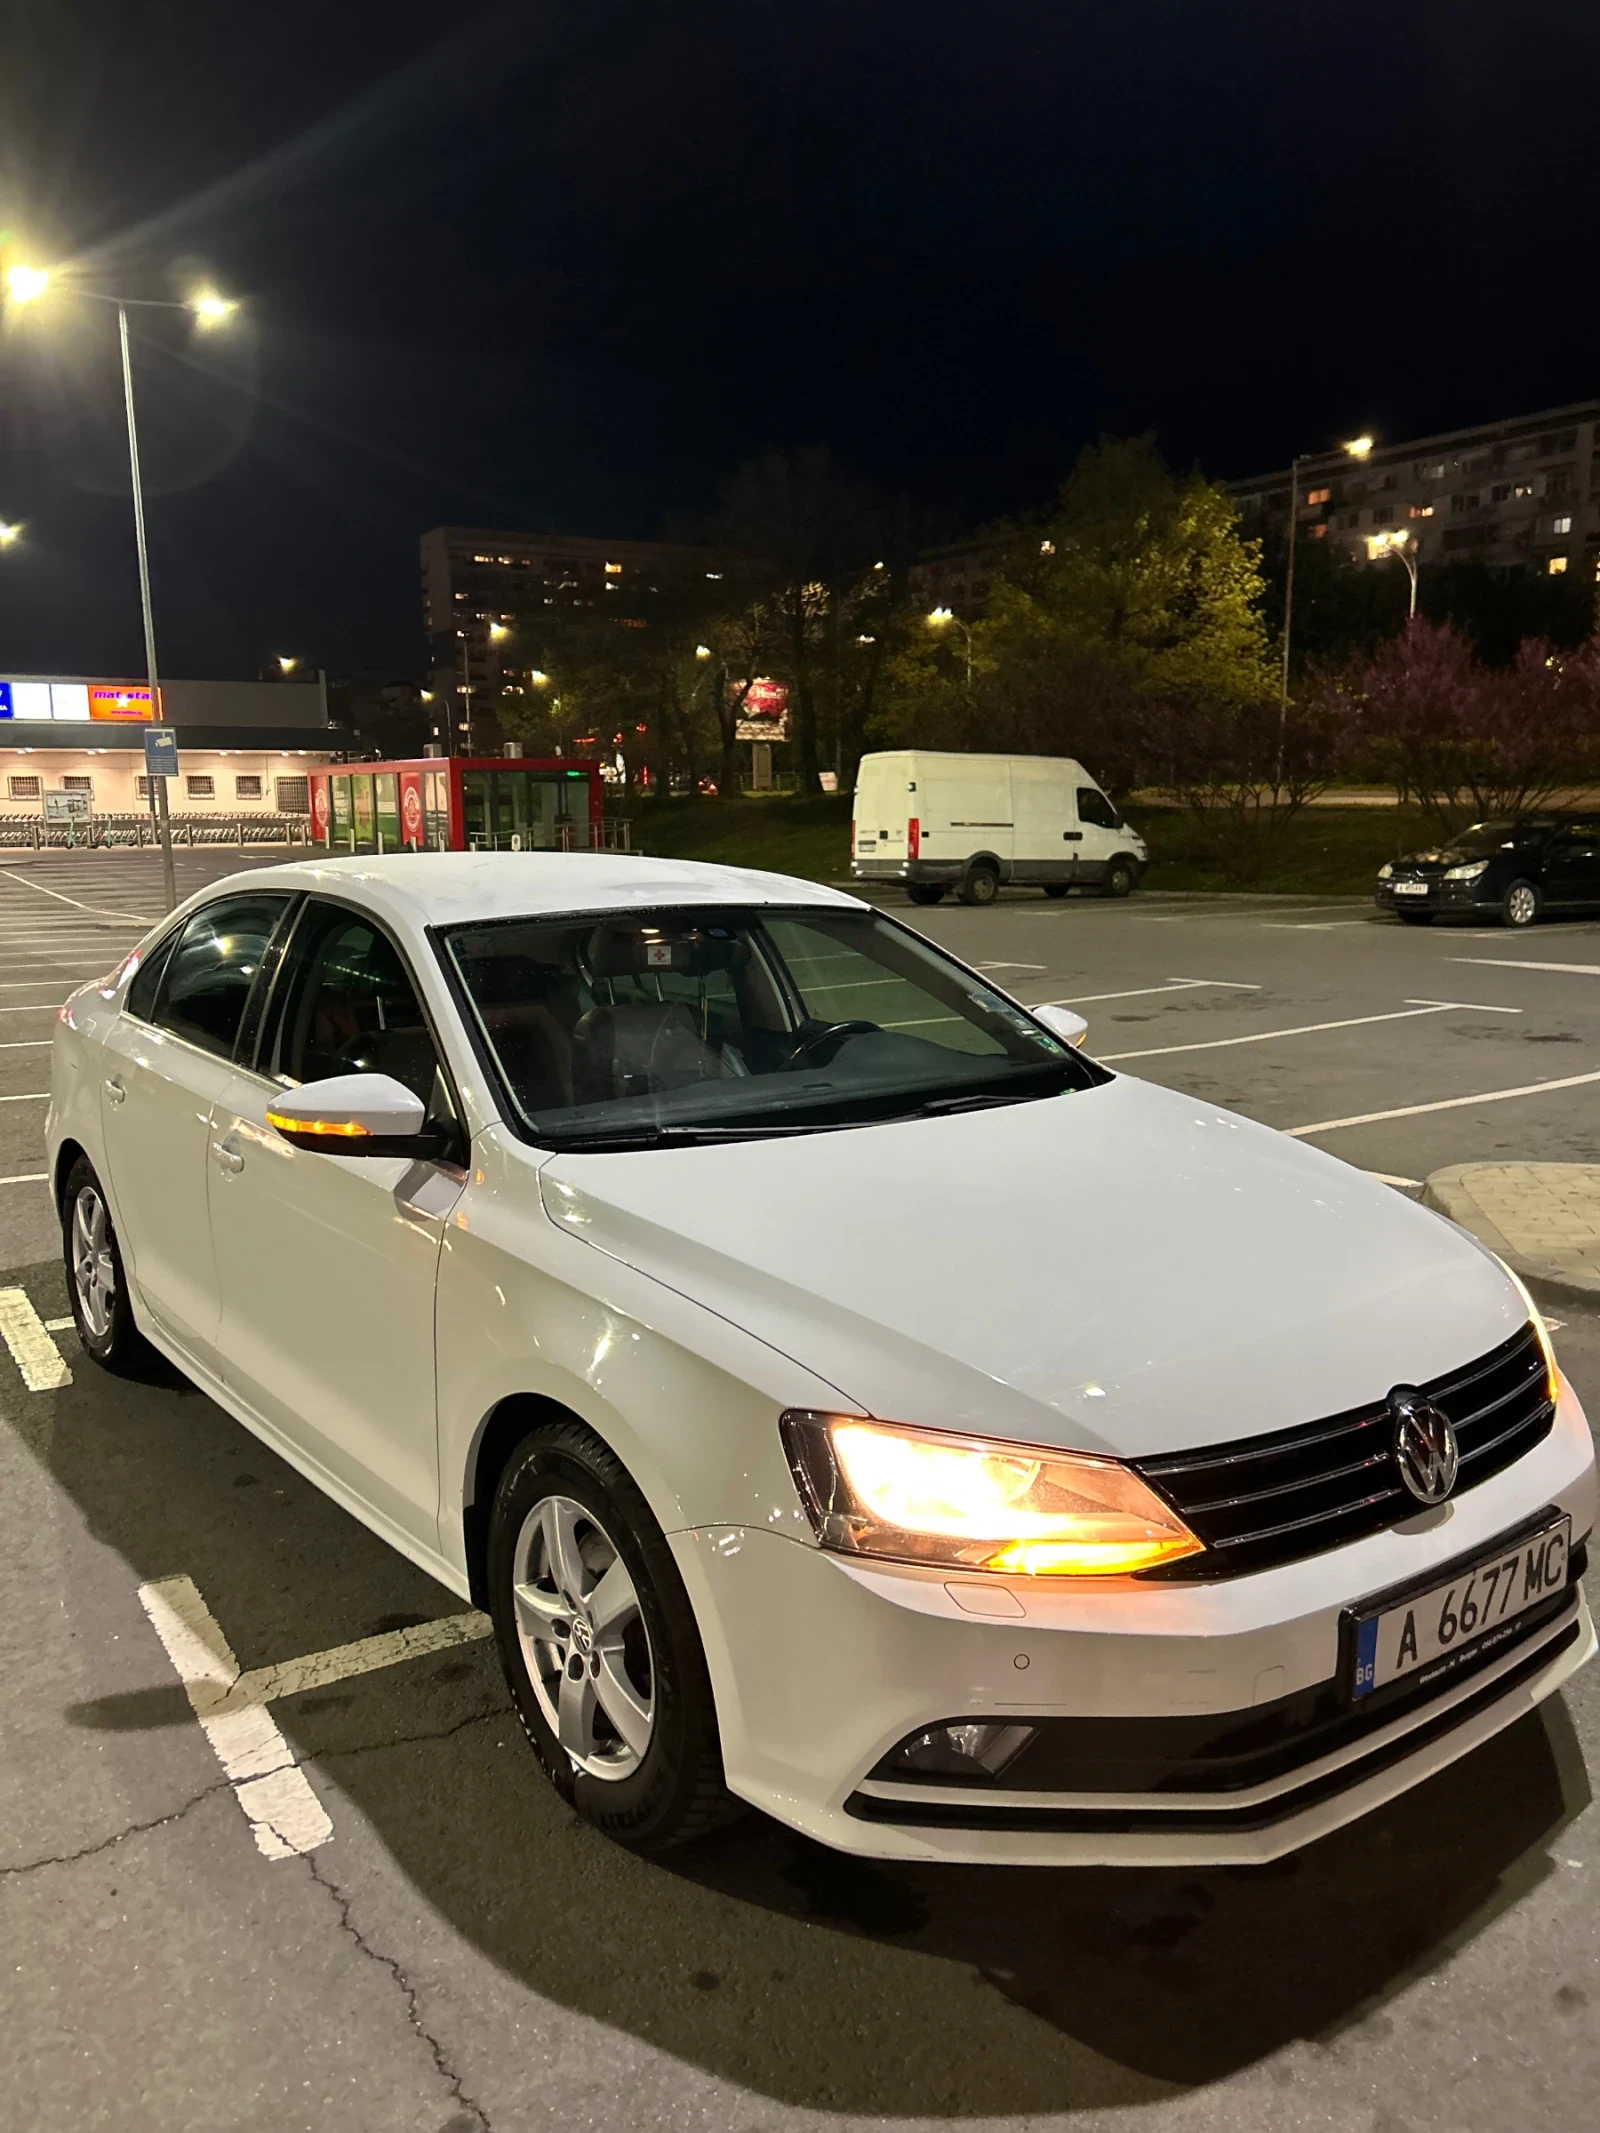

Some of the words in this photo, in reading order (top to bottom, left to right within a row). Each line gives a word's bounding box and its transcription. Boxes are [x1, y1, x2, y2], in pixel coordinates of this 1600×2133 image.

[1396, 1610, 1417, 1670] A
[1438, 1555, 1520, 1645] 6677
[1524, 1534, 1564, 1601] MC
[1356, 1663, 1373, 1685] BG
